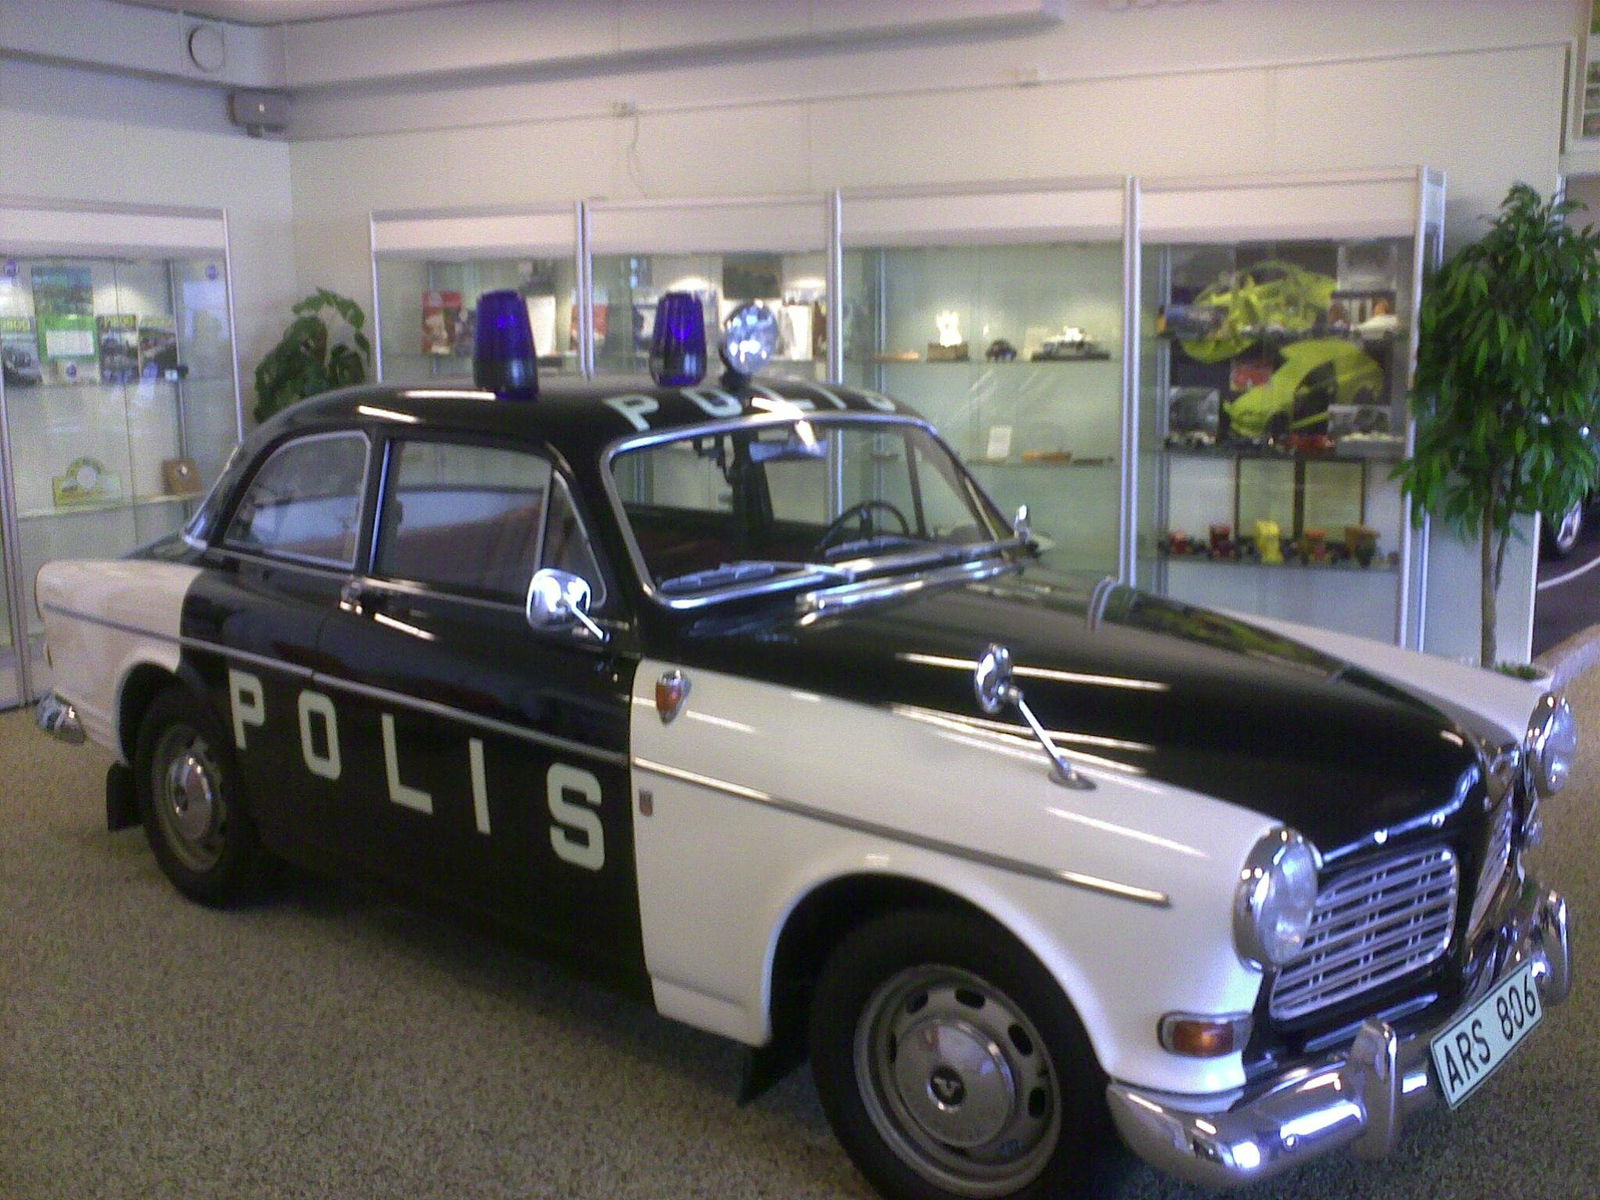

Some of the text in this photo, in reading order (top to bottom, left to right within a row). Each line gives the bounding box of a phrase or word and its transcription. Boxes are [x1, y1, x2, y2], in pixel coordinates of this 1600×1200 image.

[229, 669, 605, 871] POLIS
[1443, 973, 1536, 1094] ARS 806
